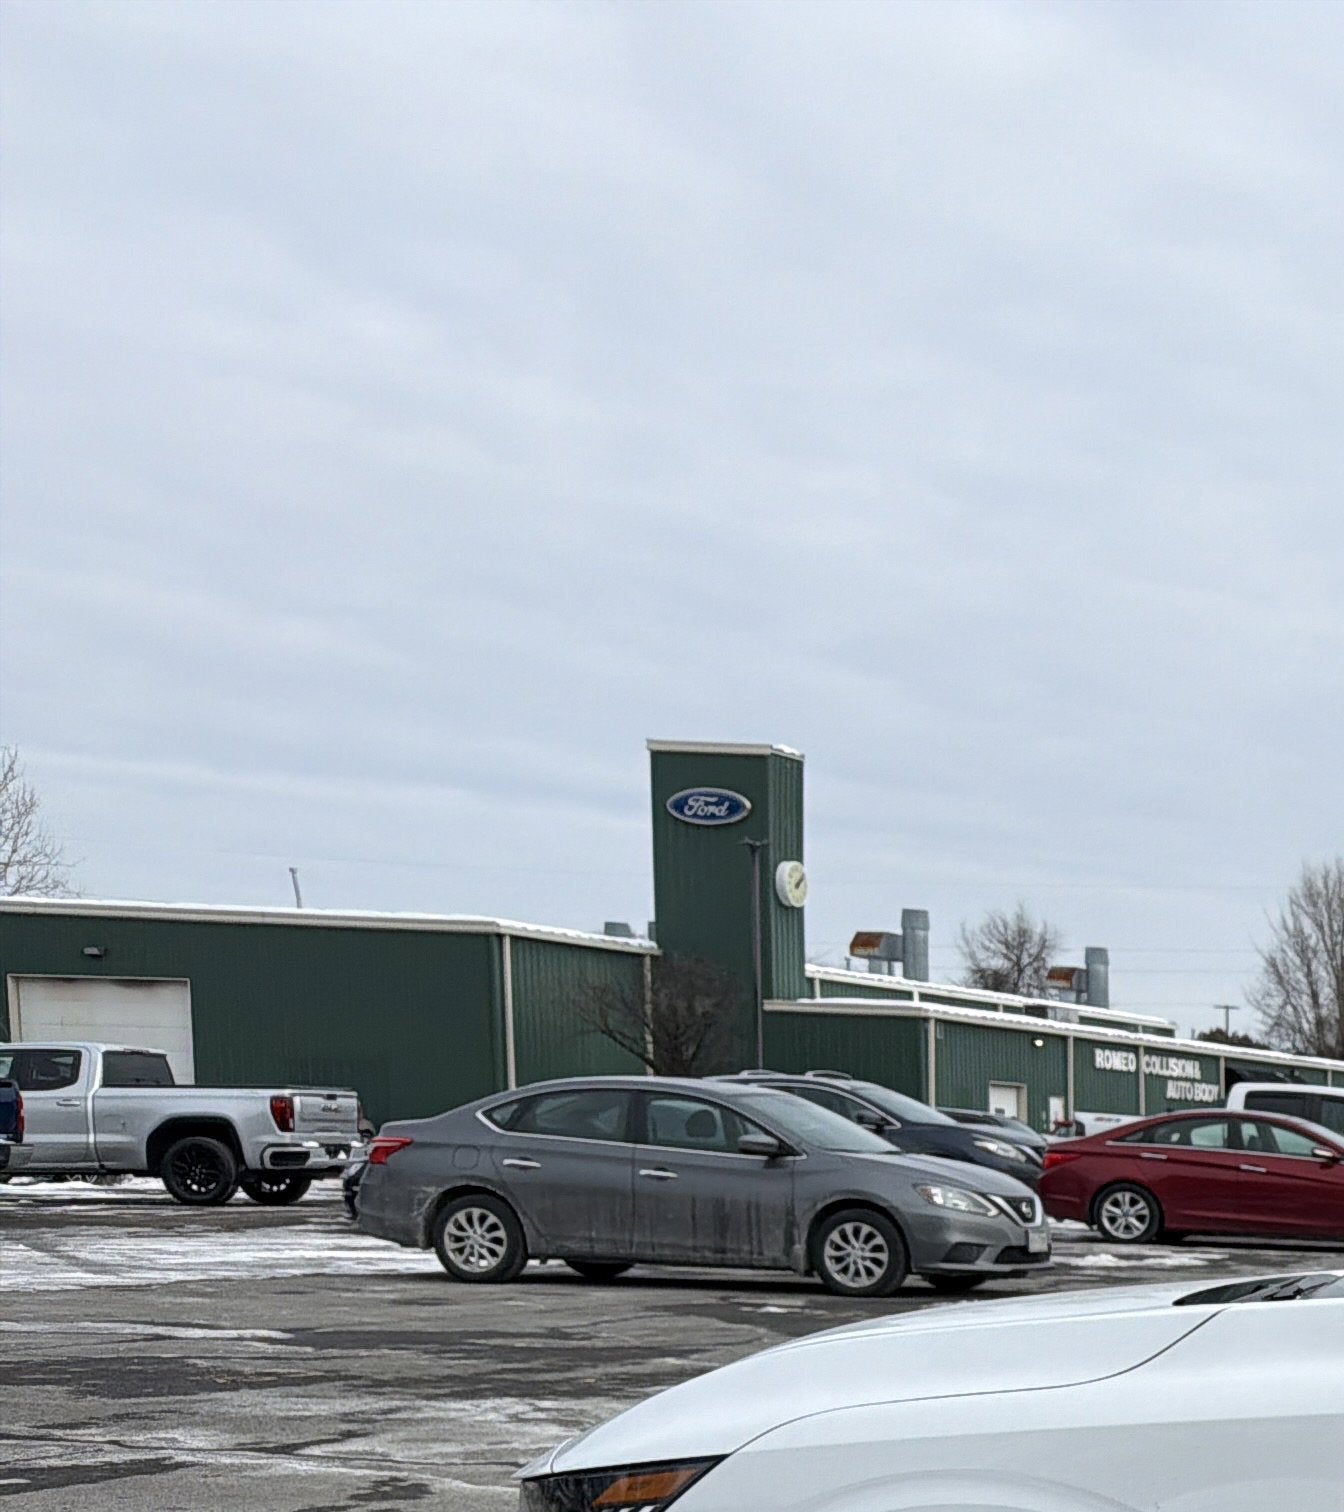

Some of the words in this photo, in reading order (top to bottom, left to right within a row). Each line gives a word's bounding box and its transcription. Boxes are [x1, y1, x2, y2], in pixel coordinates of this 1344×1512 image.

[683, 795, 730, 816] Ford
[1094, 1048, 1137, 1072] ROMEO
[1143, 1054, 1194, 1079] COLLISION
[1166, 1079, 1194, 1100] AUTO
[1194, 1081, 1220, 1103] BODY
